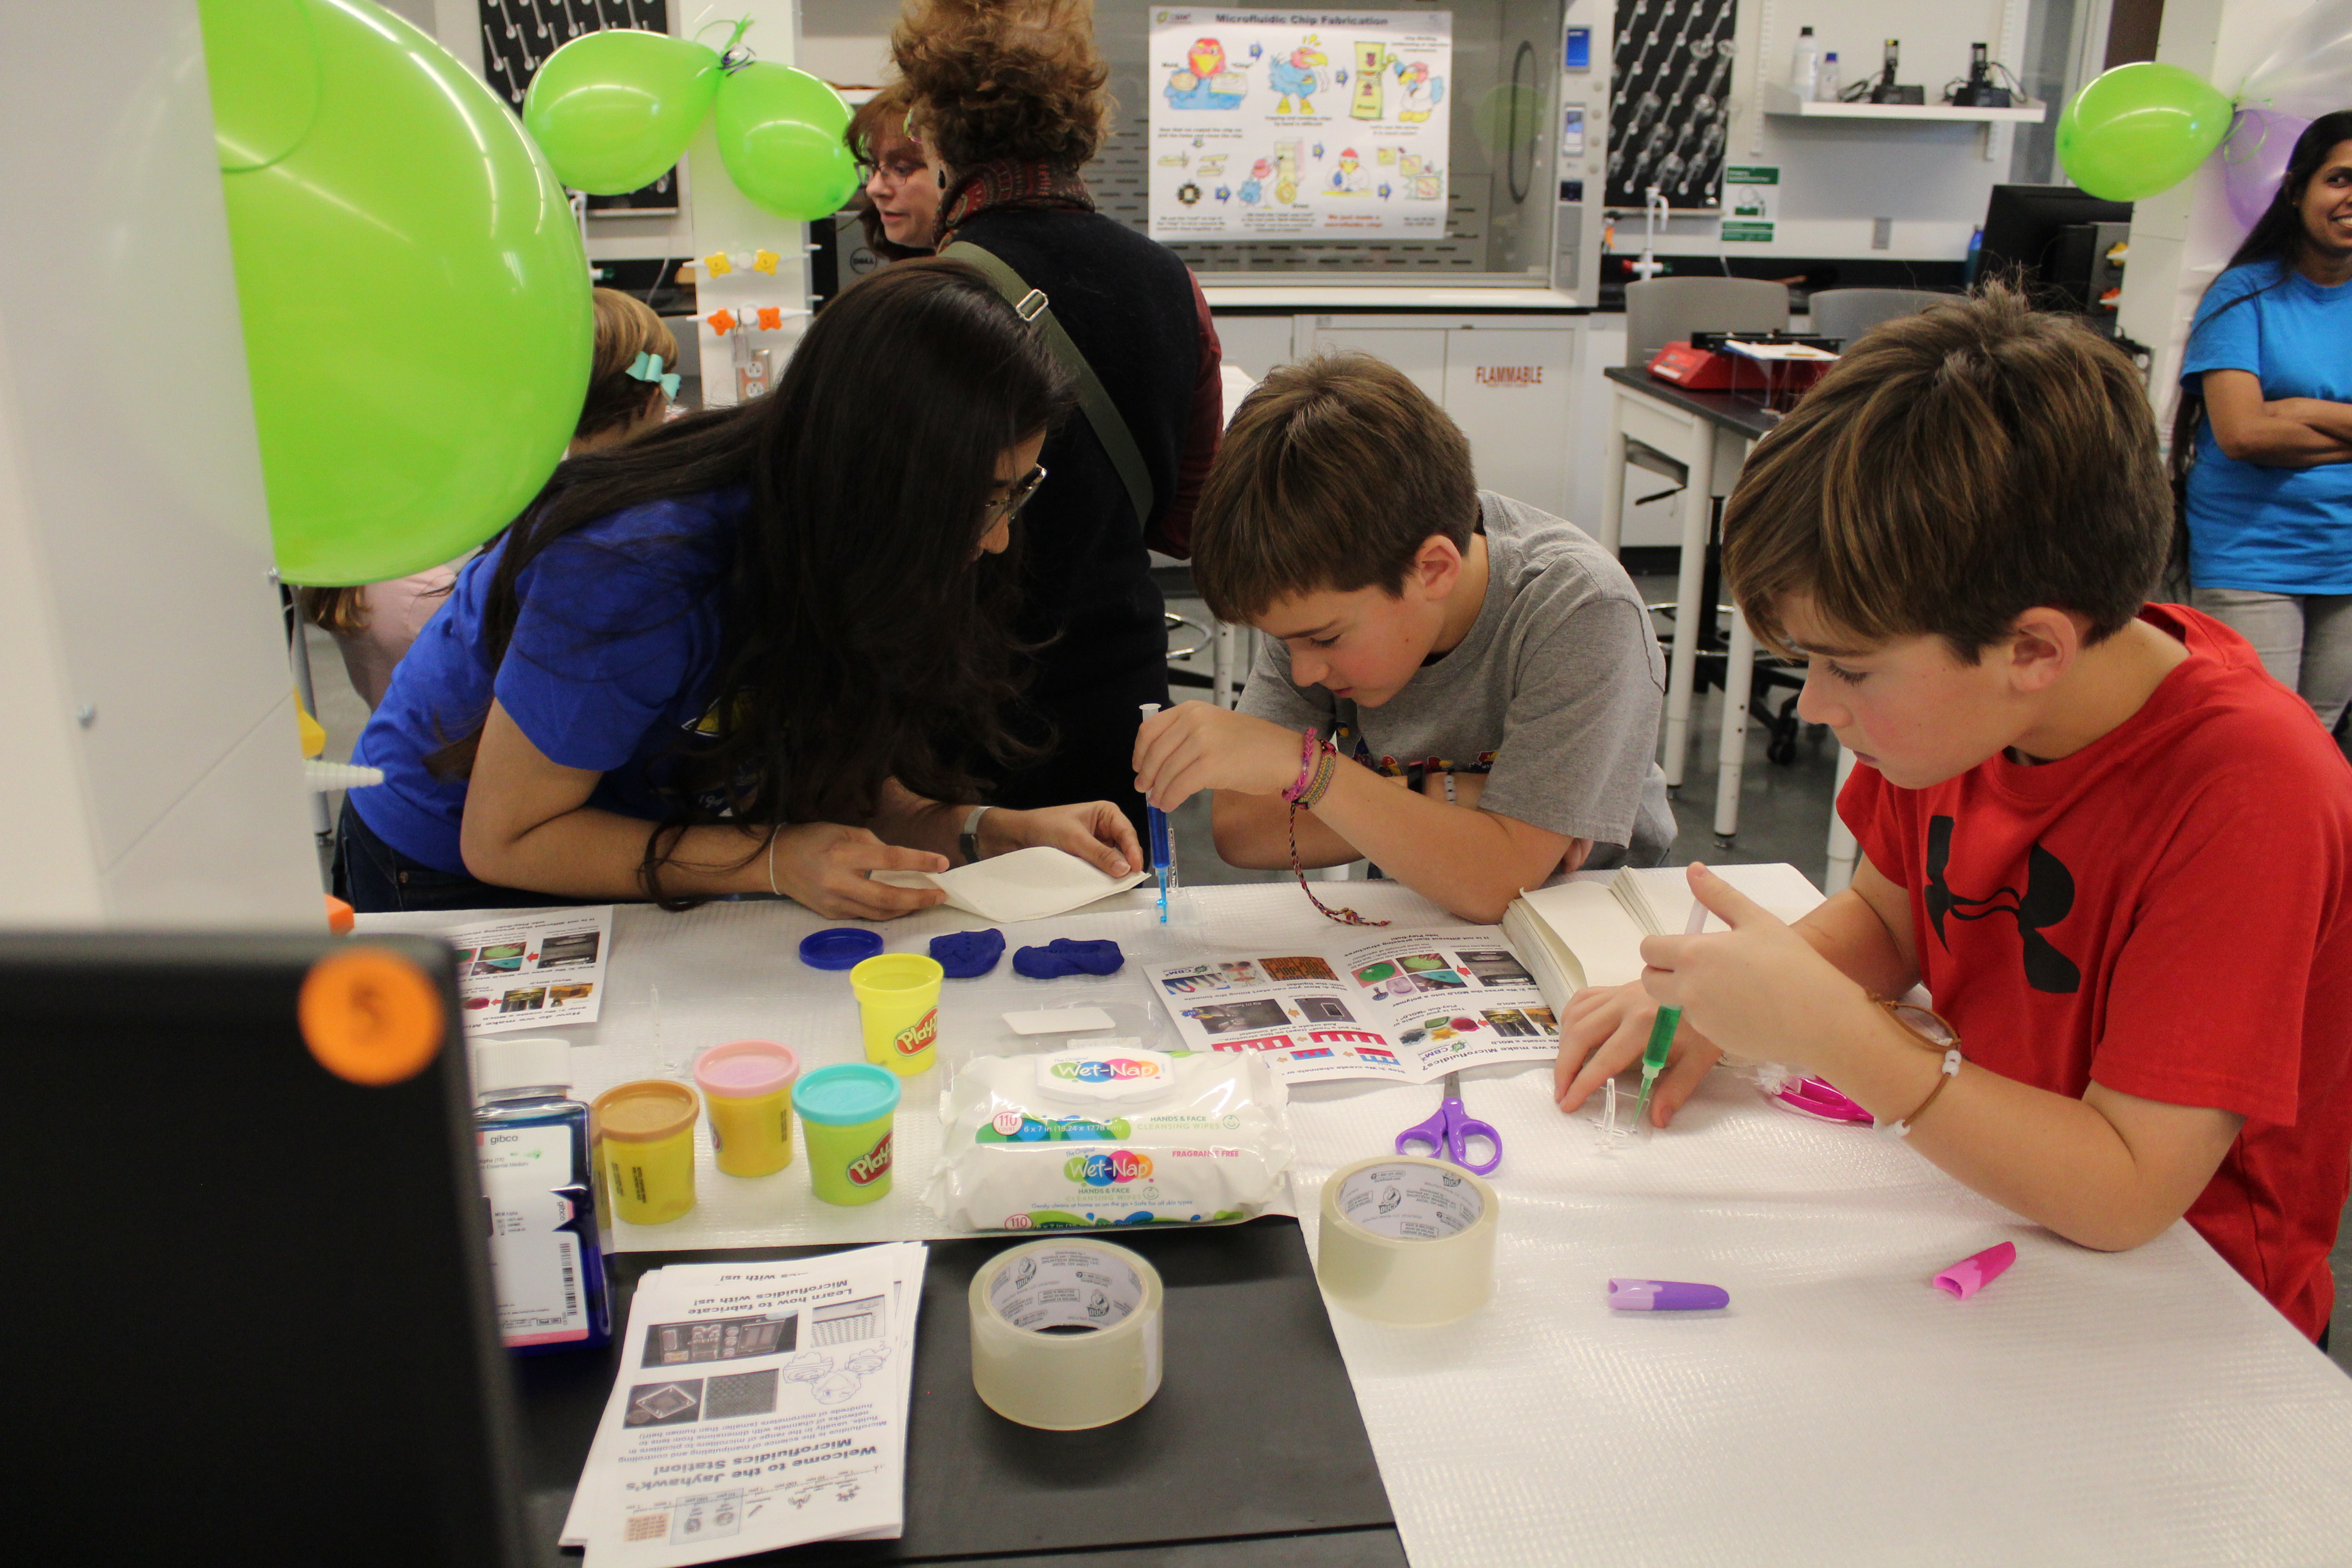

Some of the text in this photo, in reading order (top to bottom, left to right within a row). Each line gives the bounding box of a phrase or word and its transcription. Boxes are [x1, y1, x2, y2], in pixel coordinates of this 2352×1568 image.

[1216, 14, 1388, 25] Microfluidic Chip Fabrication
[1475, 367, 1544, 384] FLAMMABLE
[1382, 938, 1413, 946] pressing
[1344, 944, 1381, 957] structures
[1392, 996, 1422, 1007] polymer
[1402, 1014, 1424, 1023] cookie
[1422, 1048, 1498, 1071] Microfluidics?
[1057, 1063, 1152, 1078] Wet-Nap
[999, 1115, 1017, 1126] 110
[490, 1135, 518, 1145] gibco
[1069, 1159, 1147, 1179] Wet-Nap
[557, 1201, 566, 1221] gibco
[1381, 1204, 1397, 1213] DUCK
[1010, 1217, 1028, 1227] 110
[1017, 1275, 1034, 1288] DUCK
[755, 1279, 848, 1300] Microfluidics
[811, 1288, 853, 1301] Learn
[719, 1295, 751, 1304] with
[776, 1297, 807, 1306] how
[687, 1303, 754, 1315] fabricate
[830, 1403, 872, 1415] hundreds
[760, 1413, 816, 1426] micrometers
[828, 1411, 869, 1422] networks
[850, 1416, 878, 1424] fluids,
[721, 1421, 758, 1431] (smaller
[773, 1421, 813, 1431] channels
[815, 1421, 848, 1431] usually
[828, 1421, 887, 1435] Microfluidics
[696, 1431, 749, 1441] dimensions
[759, 1432, 785, 1441] range
[696, 1438, 745, 1447] microliters
[764, 1437, 799, 1447] science
[639, 1443, 681, 1453] picoliters
[690, 1445, 750, 1456] manipulating
[617, 1453, 668, 1463] controlling
[653, 1438, 851, 1476] Microfluidics Station!
[625, 1446, 877, 1492] Welcome to the Jayhawk's
